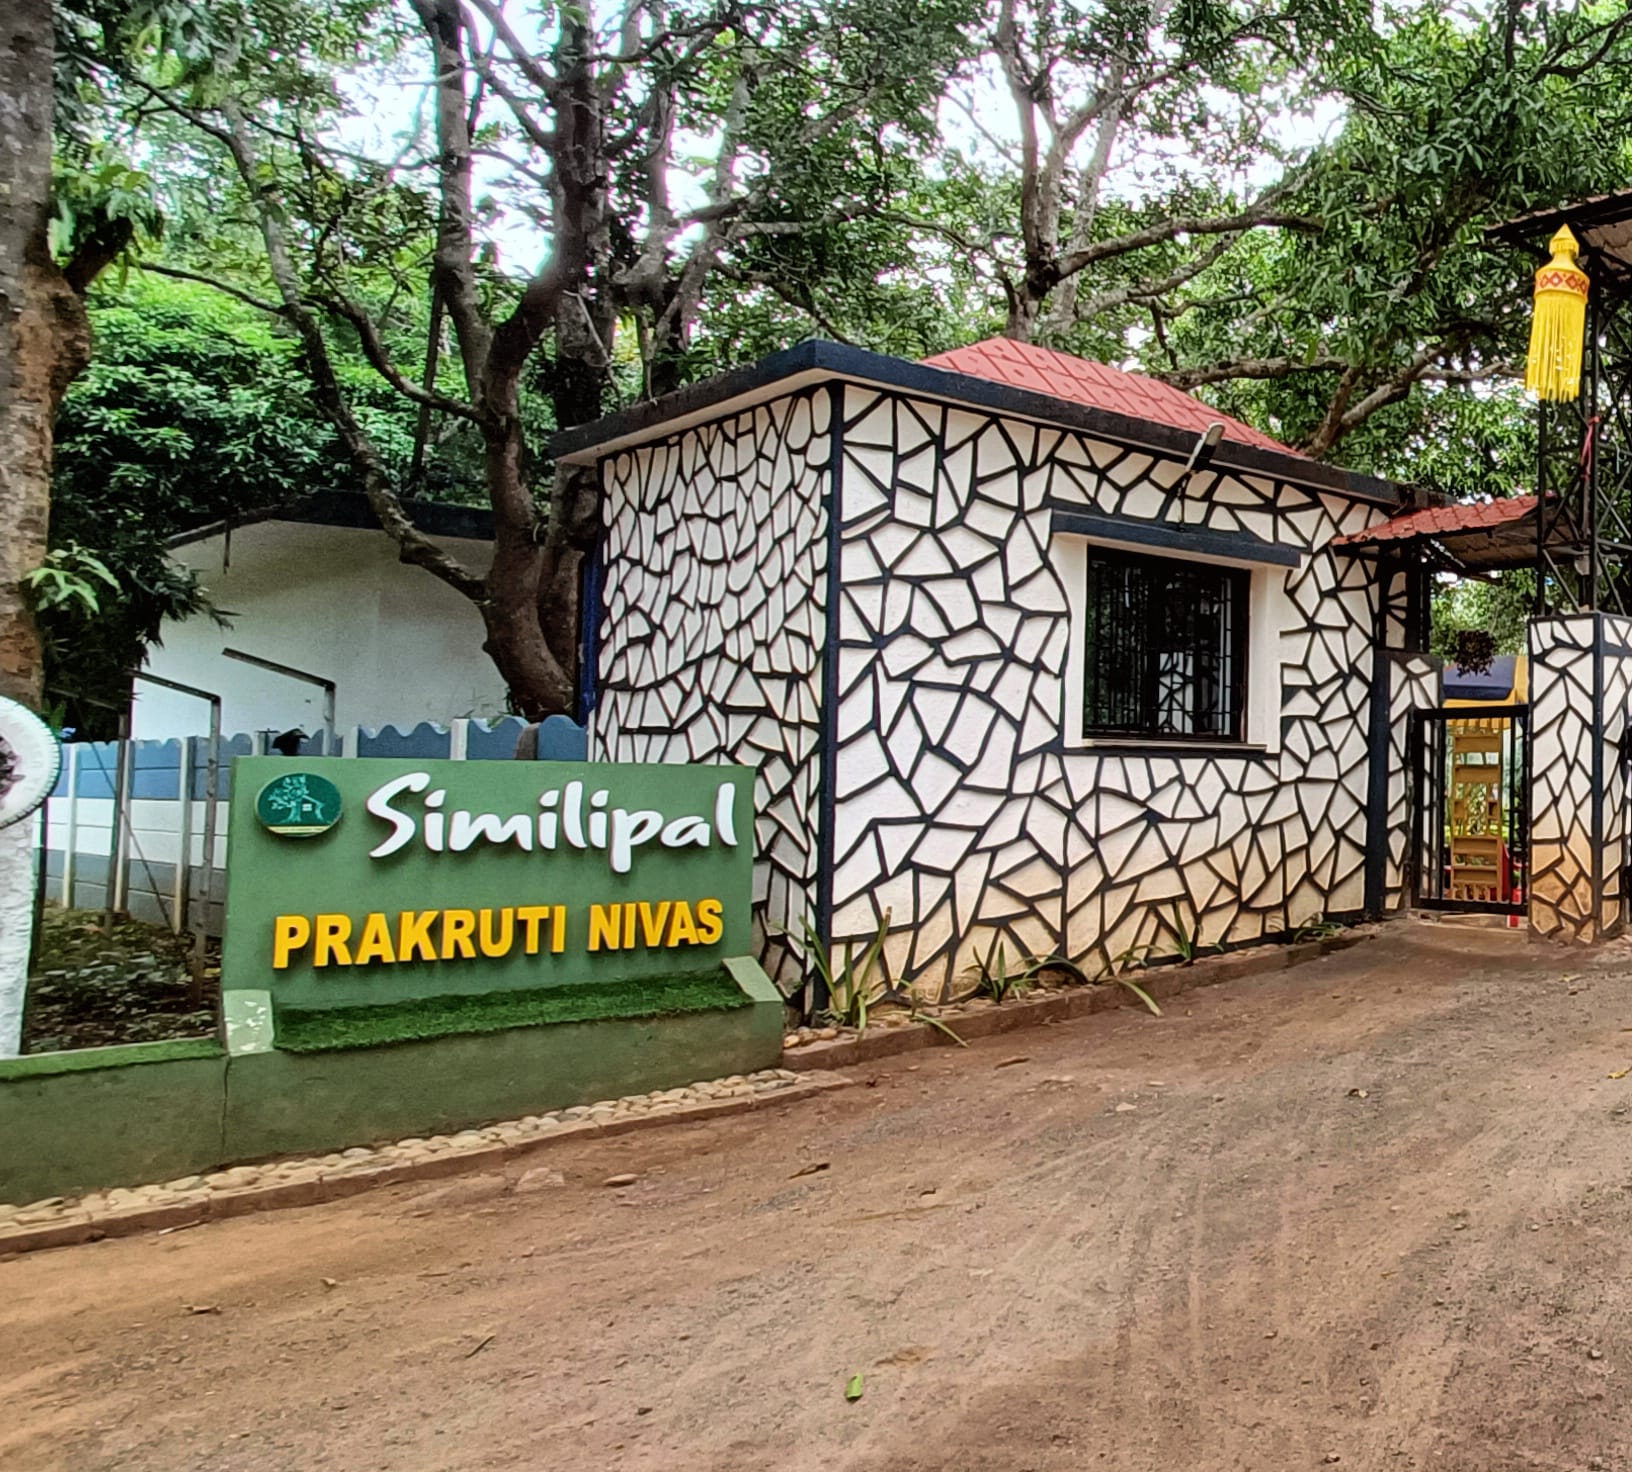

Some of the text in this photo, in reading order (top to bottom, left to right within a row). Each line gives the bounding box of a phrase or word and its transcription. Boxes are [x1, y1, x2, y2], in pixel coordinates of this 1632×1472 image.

[366, 772, 737, 873] Similipal
[272, 899, 723, 969] PRAKRUTI NIVAS
